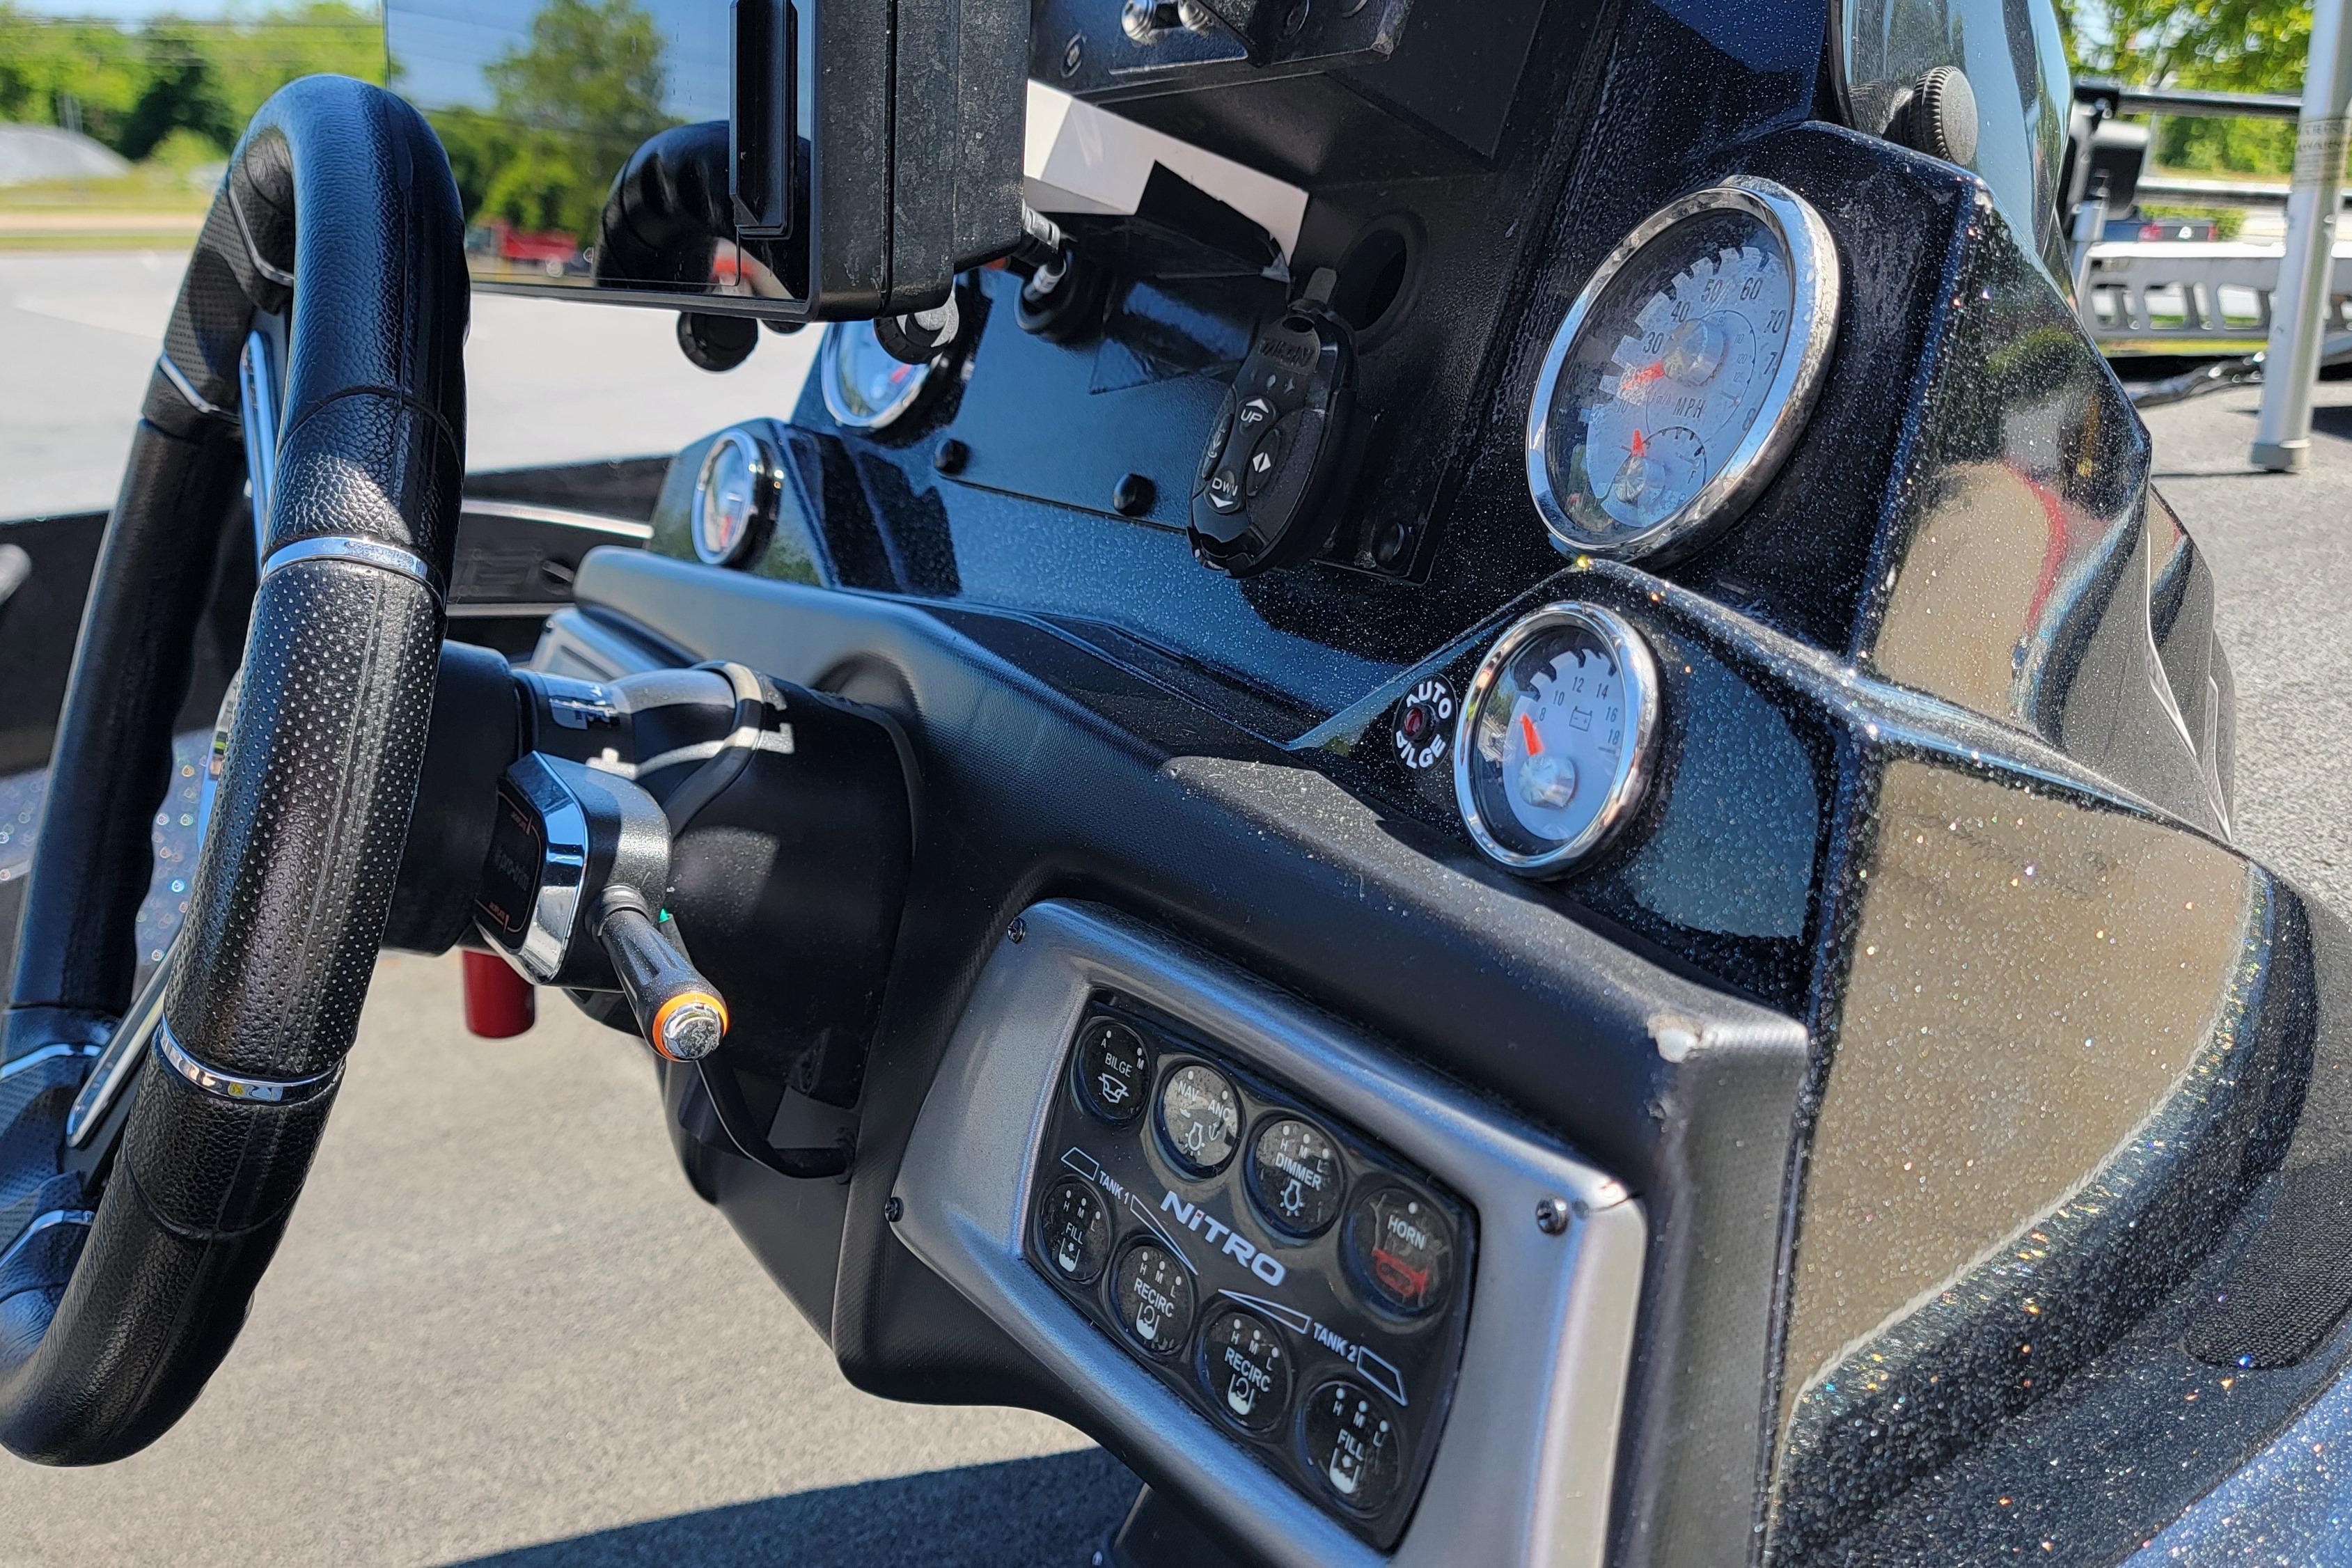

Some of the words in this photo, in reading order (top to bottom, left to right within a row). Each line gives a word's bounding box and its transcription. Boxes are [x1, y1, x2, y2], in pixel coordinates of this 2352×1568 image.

[1701, 279, 1723, 302] 50
[1740, 277, 1763, 300] 60
[1670, 301, 1691, 322] 40
[1764, 309, 1787, 334] 70
[1643, 331, 1663, 354] 30
[1240, 408, 1263, 423] UP
[1673, 397, 1706, 419] MPH
[1212, 477, 1239, 496] DWN
[1572, 676, 1584, 693] 12
[1596, 682, 1609, 700] 14
[1406, 680, 1452, 719] AUTO
[1553, 690, 1565, 707] 10
[1539, 707, 1546, 721] 8
[1606, 706, 1618, 723] 16
[1608, 728, 1620, 745] 18
[1395, 730, 1446, 769] BILGE
[1100, 1037, 1107, 1049] A
[1104, 1052, 1133, 1078] BILGE
[1136, 1057, 1145, 1070] M
[1177, 1080, 1200, 1101] NAV
[1208, 1099, 1231, 1121] ANC
[1280, 1138, 1289, 1152] H
[1299, 1144, 1308, 1159] M
[1275, 1152, 1322, 1191] DIMMER
[1316, 1159, 1324, 1173] L
[1099, 1170, 1124, 1200] TANK
[1123, 1191, 1130, 1205] 1
[1063, 1200, 1070, 1212] H
[1077, 1205, 1085, 1219] M
[1065, 1221, 1083, 1246] FILL
[1090, 1219, 1096, 1232] L
[1388, 1214, 1426, 1251] HORN
[1139, 1262, 1147, 1276] H
[1154, 1271, 1163, 1285] M
[1134, 1277, 1175, 1318] RECIRC
[1170, 1285, 1176, 1299] L
[1230, 1330, 1240, 1345] H
[1313, 1322, 1348, 1357] TANK
[1347, 1344, 1358, 1363] 2
[1248, 1339, 1259, 1356] M
[1224, 1347, 1271, 1393] RECIRC
[1265, 1356, 1273, 1372] L
[1333, 1400, 1344, 1417] H
[1353, 1411, 1365, 1429] M
[1337, 1428, 1364, 1462] FILL
